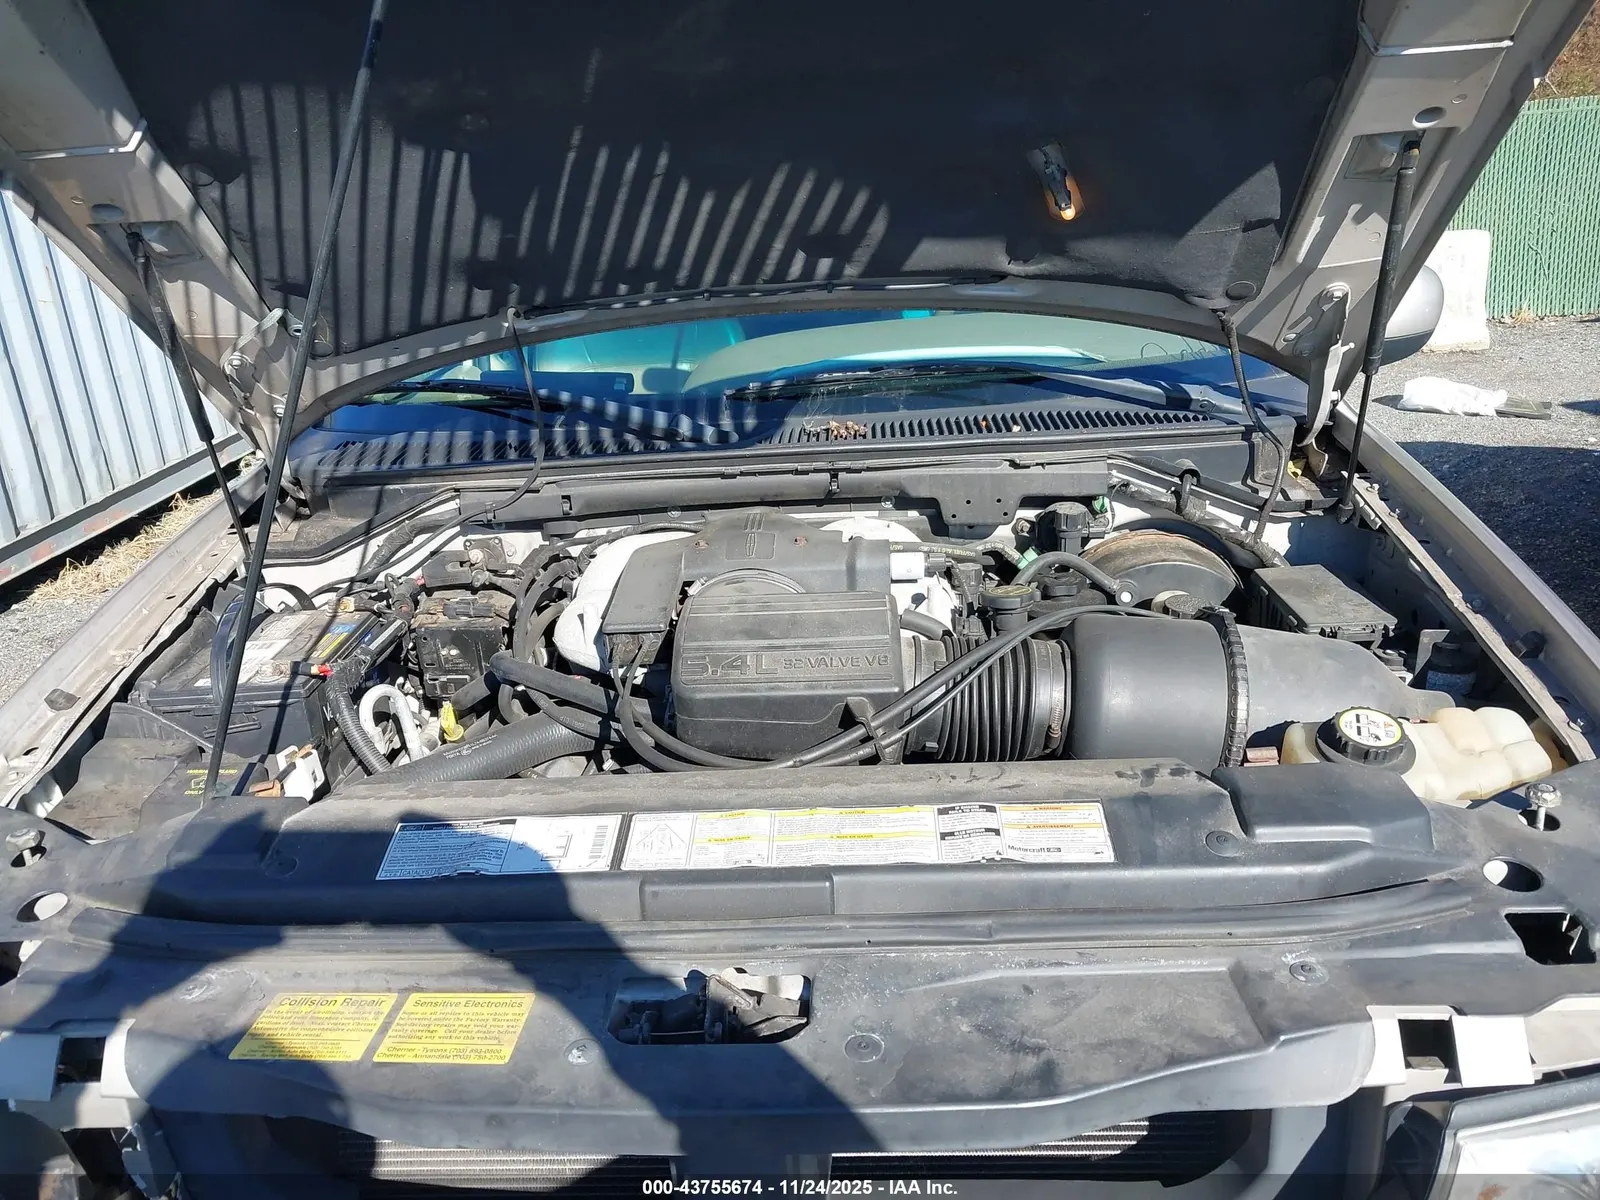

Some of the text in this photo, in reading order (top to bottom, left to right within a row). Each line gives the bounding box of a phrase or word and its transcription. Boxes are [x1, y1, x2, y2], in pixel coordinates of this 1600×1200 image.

[681, 654, 890, 677] 5.4L 32 VALVE V8
[1008, 844, 1046, 853] Motorcraft
[280, 997, 386, 1008] Collision Repair
[412, 1000, 524, 1008] Sensitive Electronics
